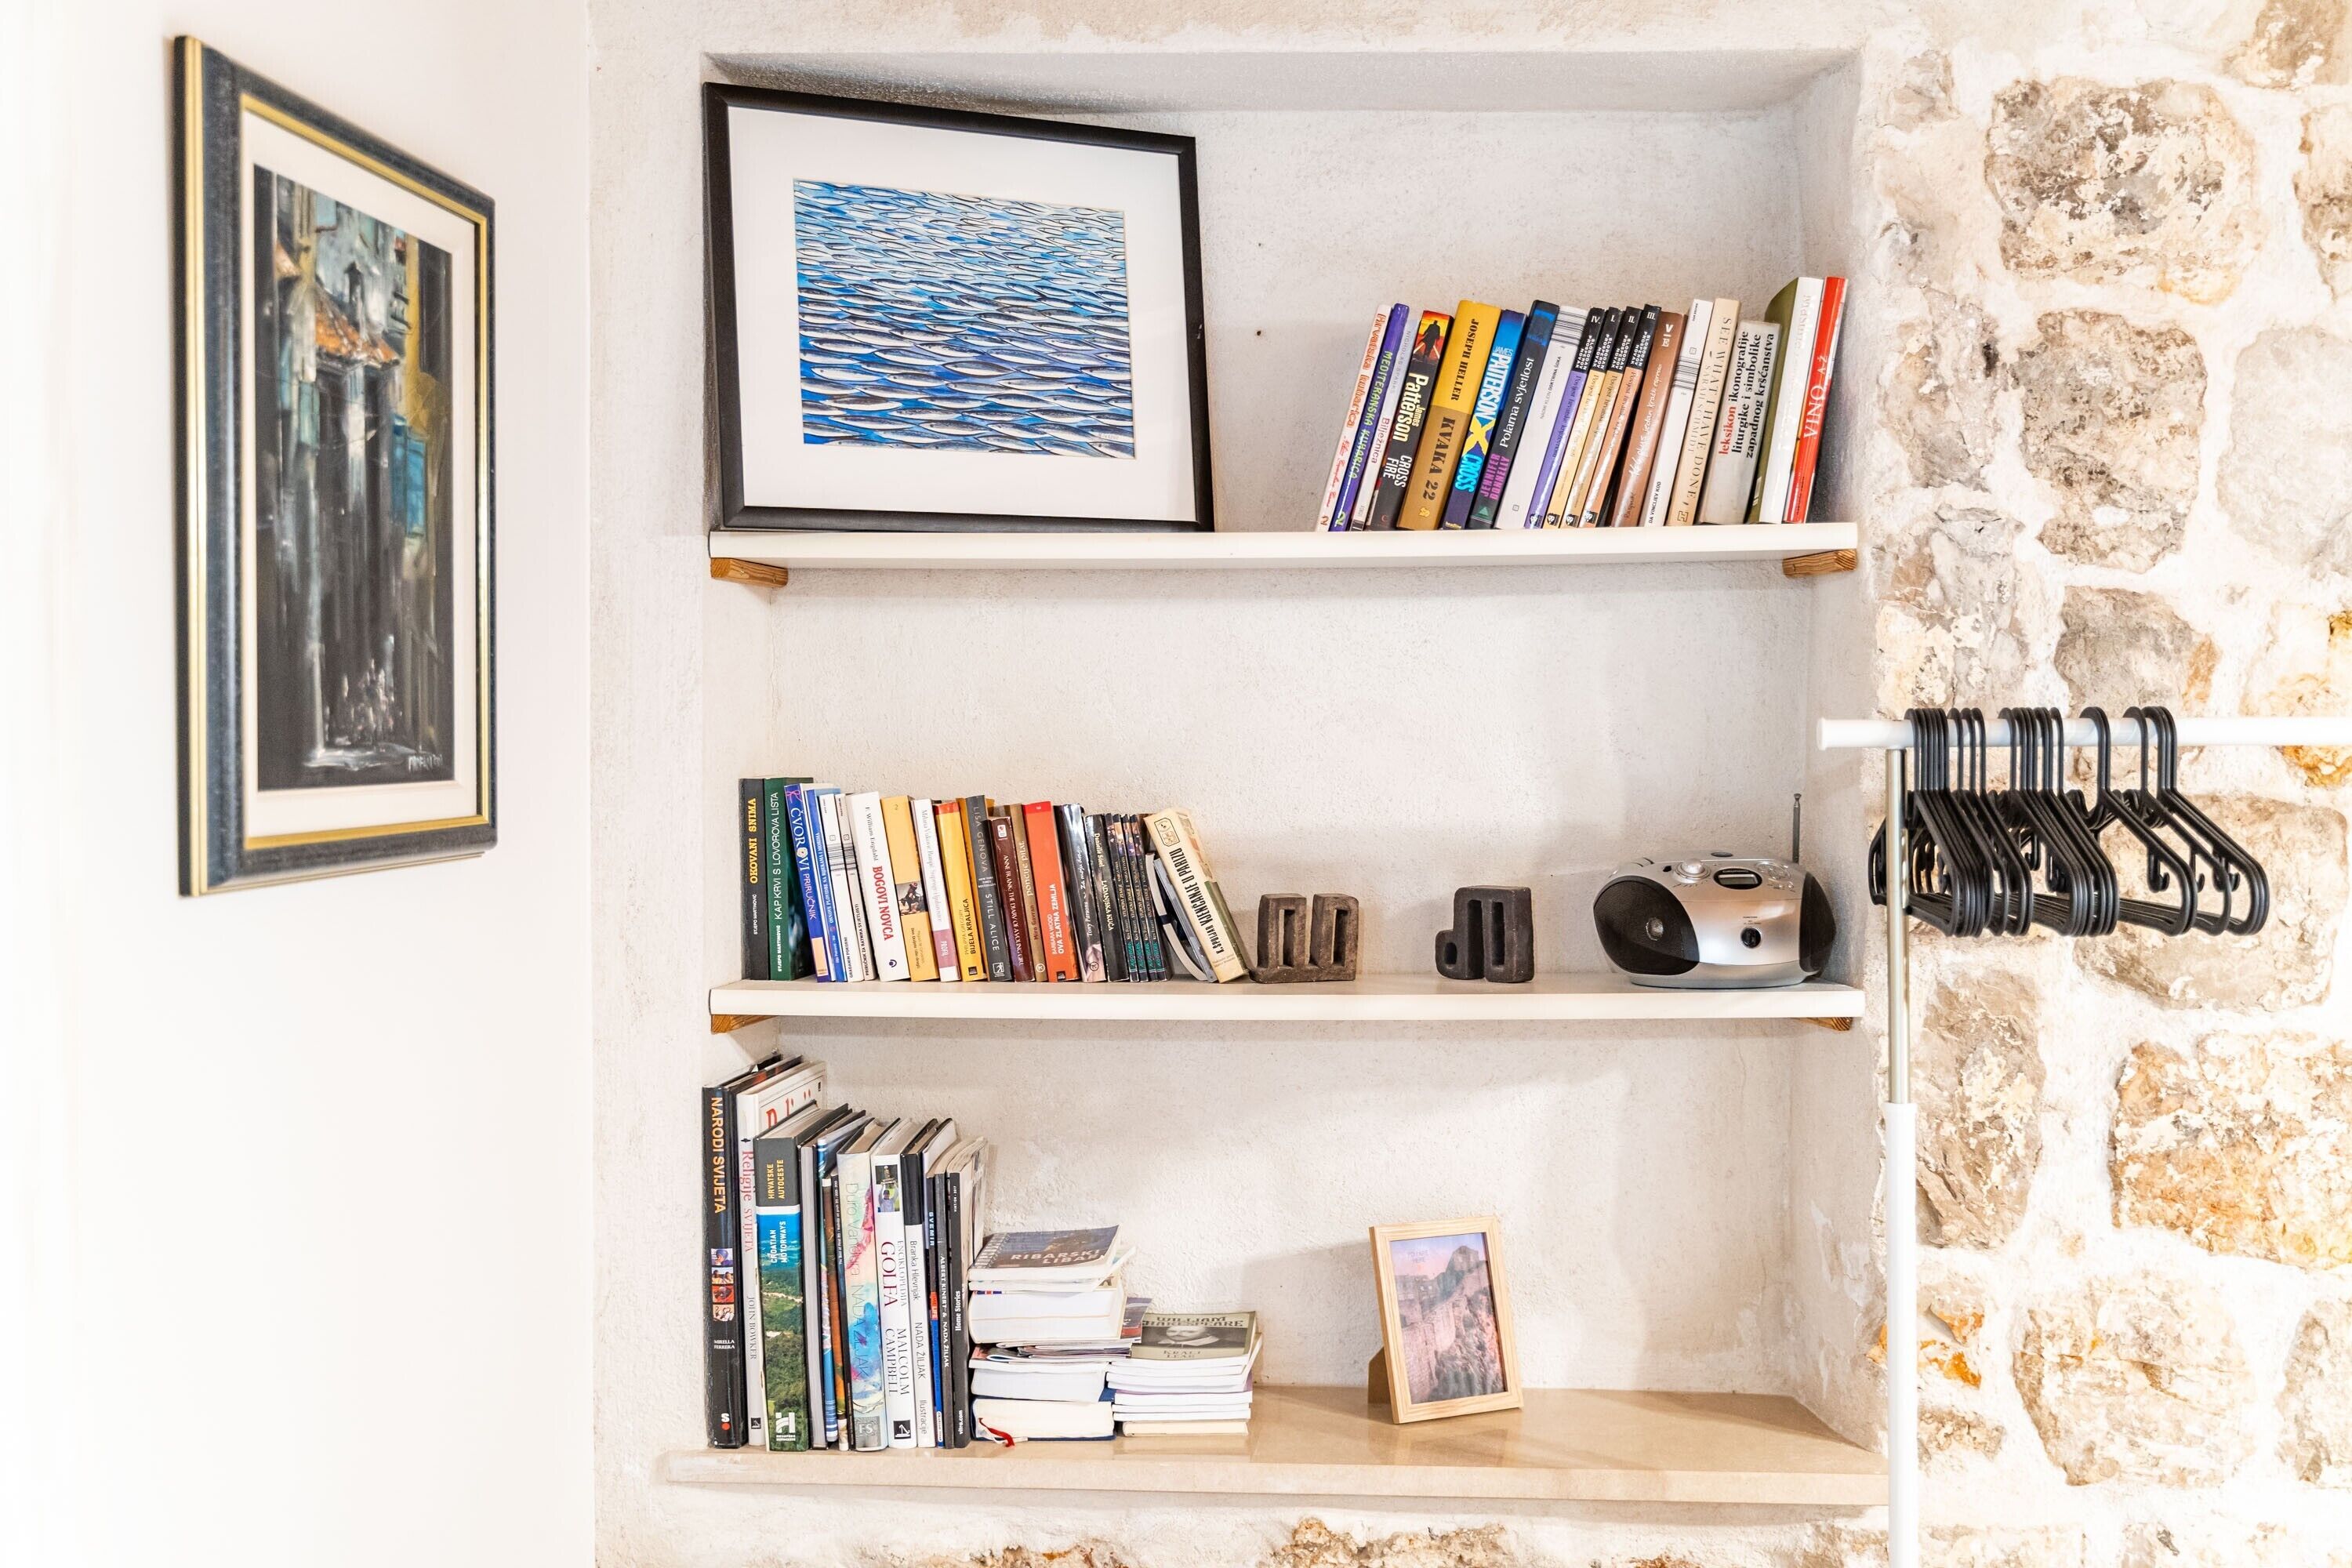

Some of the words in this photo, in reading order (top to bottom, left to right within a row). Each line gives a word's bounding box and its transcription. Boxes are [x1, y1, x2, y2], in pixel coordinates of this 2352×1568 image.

[1363, 314, 1386, 370] Hrvatska
[1465, 318, 1479, 360] JOSEPH
[1597, 334, 1610, 368] PROSPEROV
[1635, 332, 1647, 365] PROSPEROV
[1639, 335, 1650, 366] SLOBODAN
[1719, 318, 1732, 346] SEE
[1494, 347, 1513, 357] JAMES
[1575, 349, 1584, 368] NOVAK
[1580, 336, 1592, 369] PROSPEROV
[1583, 339, 1595, 370] SLOBODAN
[1593, 347, 1602, 367] NOVAK
[1601, 338, 1612, 369] SLOBODAN
[1611, 348, 1620, 368] NOVAK
[1616, 335, 1628, 369] PROSPEROV
[1619, 339, 1631, 370] SLOBODAN
[1631, 345, 1639, 365] NOVAK
[1364, 351, 1392, 426] MEDITERANSKA
[1451, 362, 1468, 401] HELLER
[1474, 352, 1512, 419] PATTERSON
[1548, 369, 1557, 391] DOKTRINA
[1709, 351, 1726, 395] WHAT
[1347, 375, 1369, 427] kuharica
[1393, 372, 1429, 442] Patterson
[1499, 403, 1521, 448] Polarna
[1515, 358, 1534, 404] svjetlost
[1719, 406, 1737, 456] leksikon
[1729, 331, 1748, 402] ikonografije
[1732, 404, 1750, 453] liturgike
[1746, 334, 1762, 393] simbolike
[1746, 401, 1763, 459] zapadnog
[1759, 333, 1774, 397] kršćanstva
[1804, 384, 1825, 439] VINO
[1817, 355, 1828, 375] A-Ž
[1412, 405, 1423, 426] James
[1697, 410, 1713, 450] HAVE
[1348, 429, 1370, 478] KUHARICA
[1371, 417, 1390, 463] Bilježnica
[1429, 416, 1456, 474] KVAKA
[1383, 457, 1399, 479] FIRE
[1395, 456, 1412, 488] CROSS
[1454, 453, 1484, 492] CROSS
[1479, 454, 1501, 498] JENNIFER
[1490, 457, 1511, 500] DONNELLY
[1687, 456, 1704, 499] DONE
[1423, 479, 1439, 501] 22
[748, 798, 757, 833] SNIMA
[771, 817, 780, 865] LOVOROVA
[978, 832, 988, 873] GENOVA
[750, 838, 758, 884] OKOVANI
[1169, 848, 1192, 877] PARIZU
[1181, 875, 1194, 884] U
[803, 873, 816, 920] PRIRUČNIK
[873, 866, 887, 905] BOGOVI
[1050, 884, 1059, 909] ZEMLJA
[1102, 880, 1110, 913] LADANJSKA
[1185, 882, 1213, 927] VJENČANJE
[879, 906, 894, 942] NOVCA
[963, 899, 972, 932] KRALJICA
[985, 894, 994, 919] STILL
[989, 924, 1000, 950] ALICE
[710, 1097, 726, 1155] NARODI
[713, 1155, 728, 1214] SVIJETA
[740, 1151, 756, 1201] Religije
[742, 1208, 753, 1252] SVIJETA
[898, 1240, 907, 1306] ENCIKLOPEDIJA
[910, 1240, 920, 1267] Branka
[1011, 1249, 1100, 1260] RIBARSKI
[881, 1242, 898, 1307] GOLFA
[911, 1269, 920, 1301] Hlevnjak
[746, 1295, 756, 1320] JOHN
[851, 1285, 865, 1327] NADA
[748, 1321, 758, 1360] BOWKER
[915, 1322, 924, 1348] NADA
[885, 1328, 898, 1396] CAMPBELL
[897, 1329, 910, 1395] MALCOLM
[915, 1350, 927, 1379] ŽILJAK
[919, 1399, 927, 1435] Ilustracije
